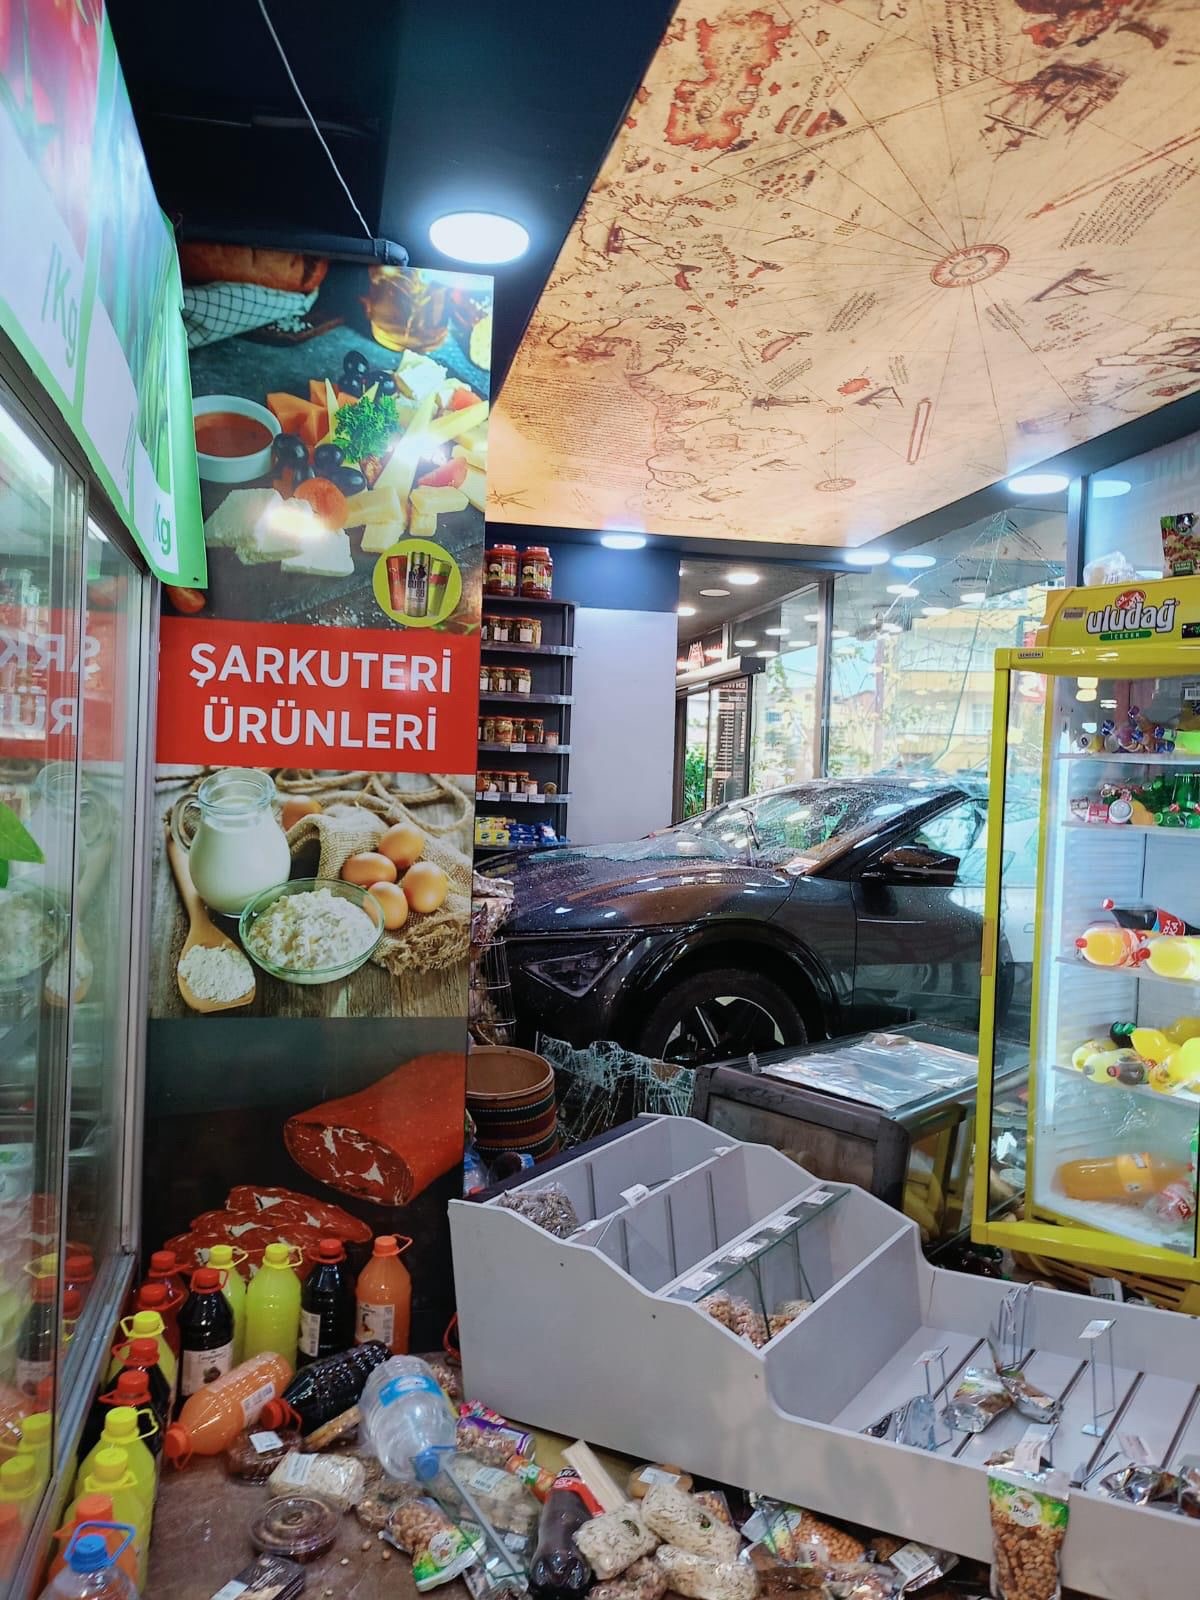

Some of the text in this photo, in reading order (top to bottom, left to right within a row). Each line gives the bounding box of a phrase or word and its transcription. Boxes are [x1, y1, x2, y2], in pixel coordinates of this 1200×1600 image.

[1086, 598, 1177, 634] uludağ
[189, 643, 451, 693] ŞARKUTERİ
[203, 696, 437, 751] ÜRÜNLERİ
